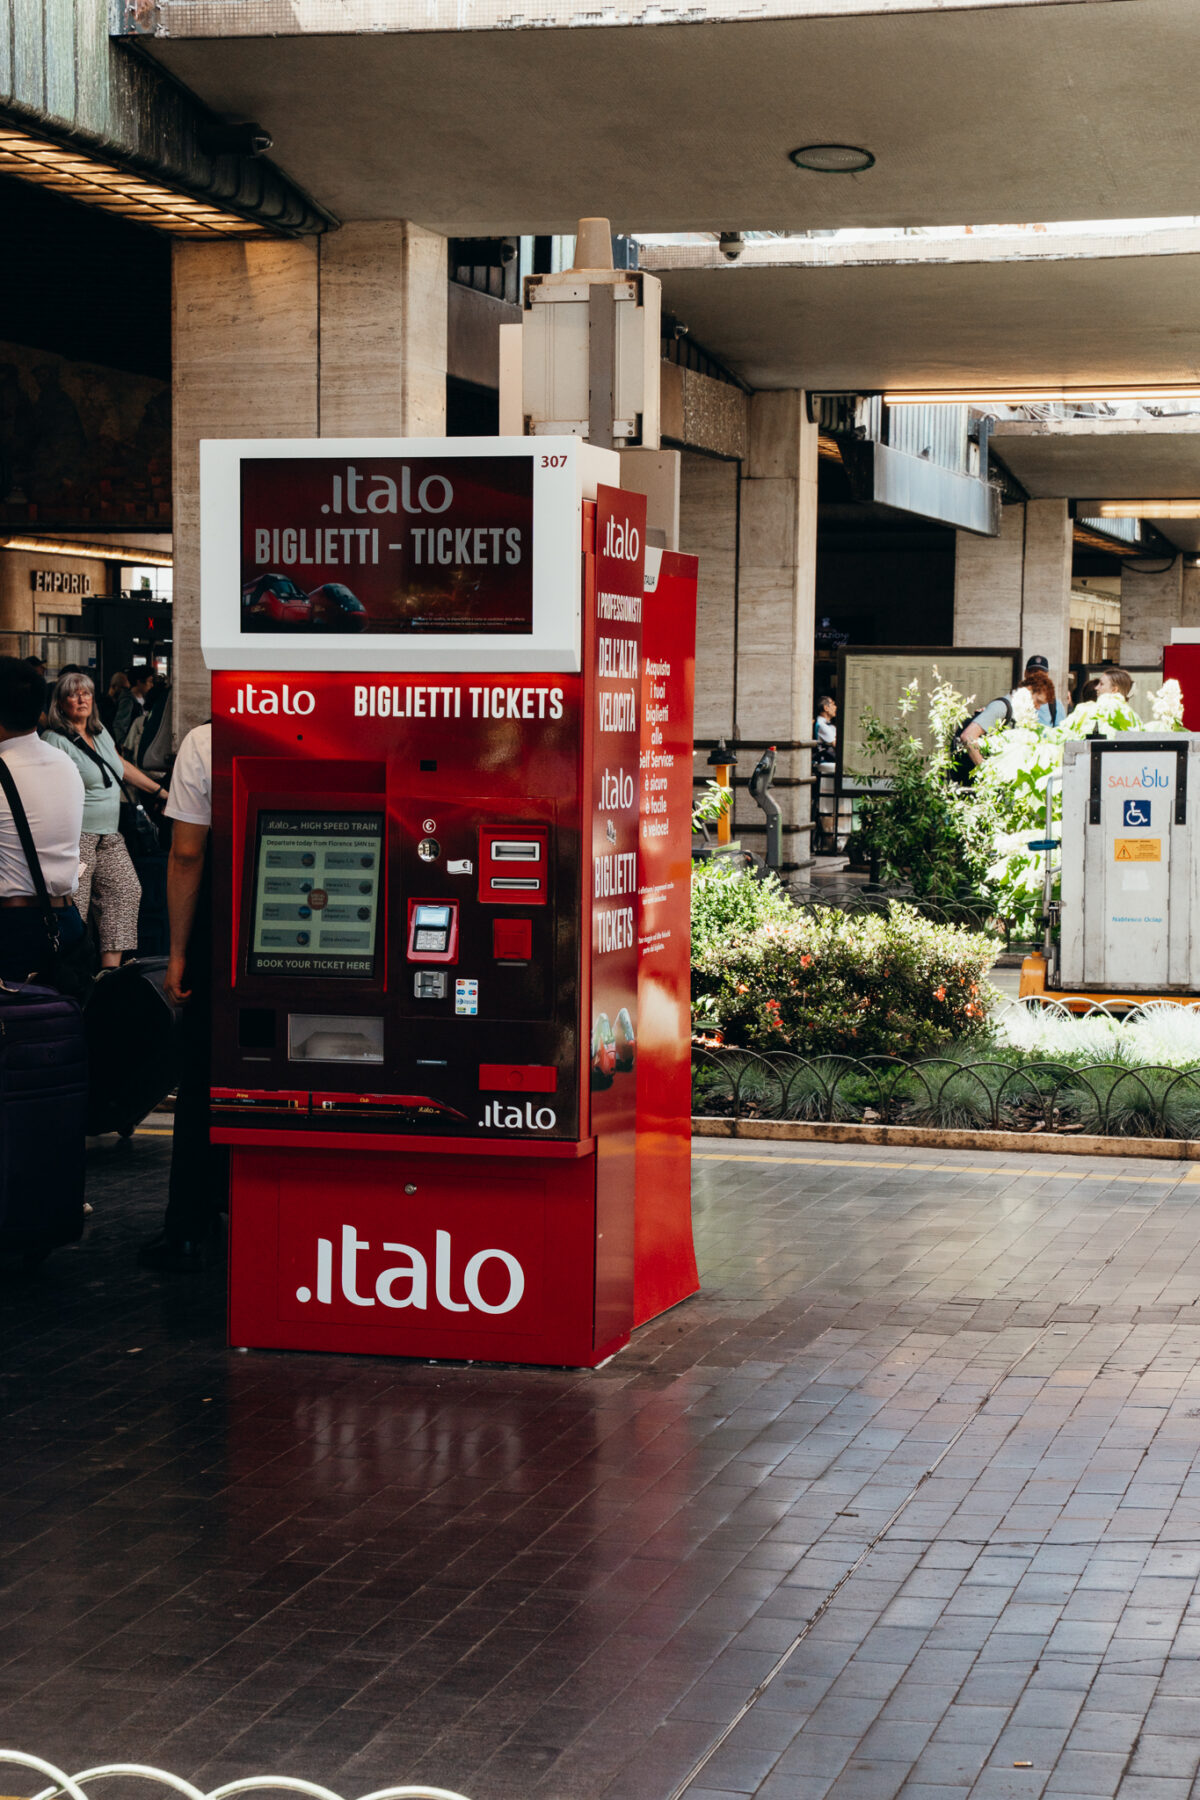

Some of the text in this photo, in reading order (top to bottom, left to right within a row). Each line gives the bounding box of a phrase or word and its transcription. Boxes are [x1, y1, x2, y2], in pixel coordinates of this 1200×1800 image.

[541, 455, 568, 468] 307
[255, 527, 379, 565] BIGLIETTI
[411, 526, 522, 565] TICKETS
[36, 571, 92, 594] EMPORIO
[601, 593, 642, 624] PROFESSIONISTI
[598, 637, 638, 679] DELL'ALTA
[645, 657, 671, 680] Acquista
[653, 682, 666, 699] tuoi
[354, 686, 564, 720] BIGLIETTI TICKETS
[599, 688, 636, 732] VELOCITÀ
[645, 704, 669, 726] biglietti
[651, 726, 662, 745] alle
[650, 773, 668, 790] sicuro
[651, 795, 667, 813] facile
[300, 822, 321, 830] HIGH
[323, 822, 349, 830] SPEED
[352, 822, 378, 831] TRAIN
[648, 818, 669, 837] veloce!
[594, 852, 636, 898] BIGLIETTI
[597, 907, 633, 954] TICKETS
[256, 959, 371, 970] BOOK YOUR TICKET HERE
